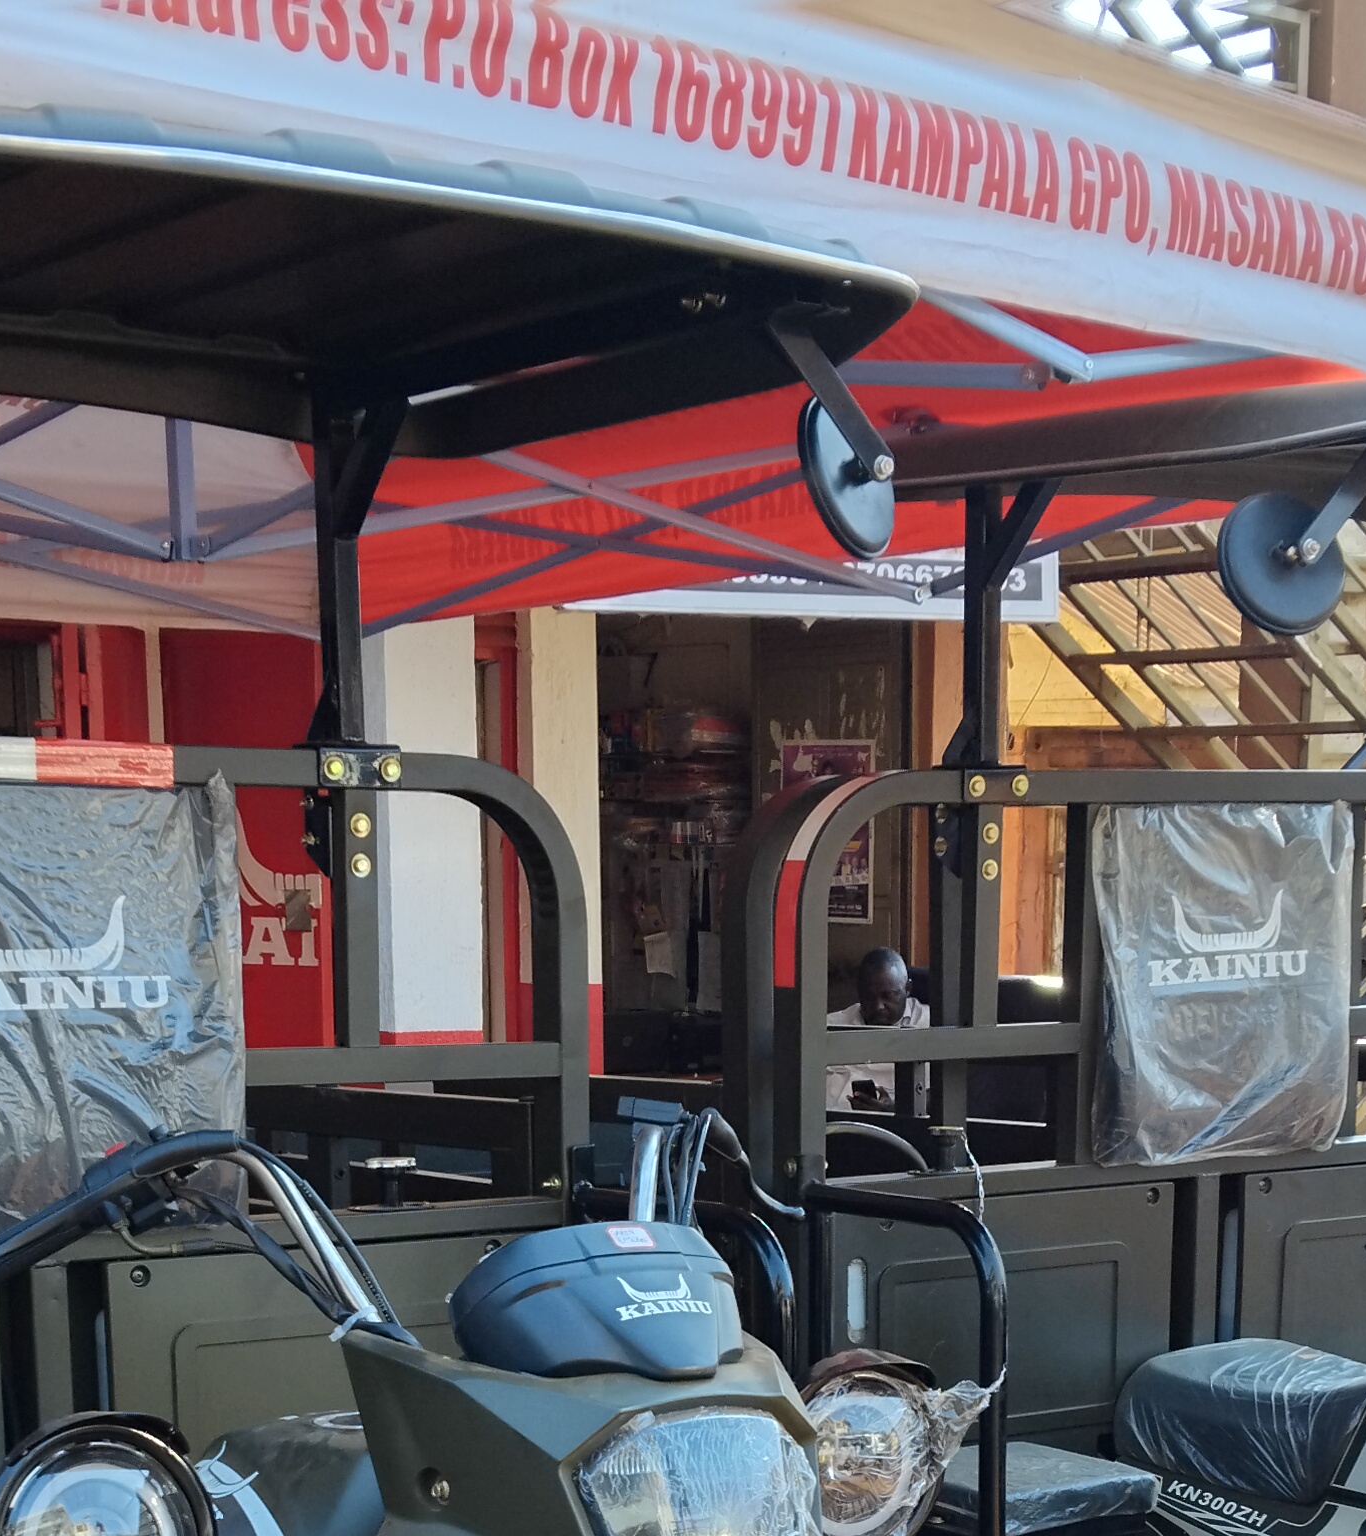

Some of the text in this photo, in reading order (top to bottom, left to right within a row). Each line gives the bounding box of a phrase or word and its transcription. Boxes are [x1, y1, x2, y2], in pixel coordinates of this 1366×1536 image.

[424, 0, 640, 127] P.O.Box
[650, 35, 840, 173] 168991
[846, 81, 1061, 223] KAMPALA
[1067, 136, 1157, 256] GPO,
[1165, 163, 1324, 284] MASAKA
[1148, 950, 1309, 988] KAINIU
[616, 1299, 712, 1322] KAINIU
[1167, 1479, 1268, 1528] KN300ZH
